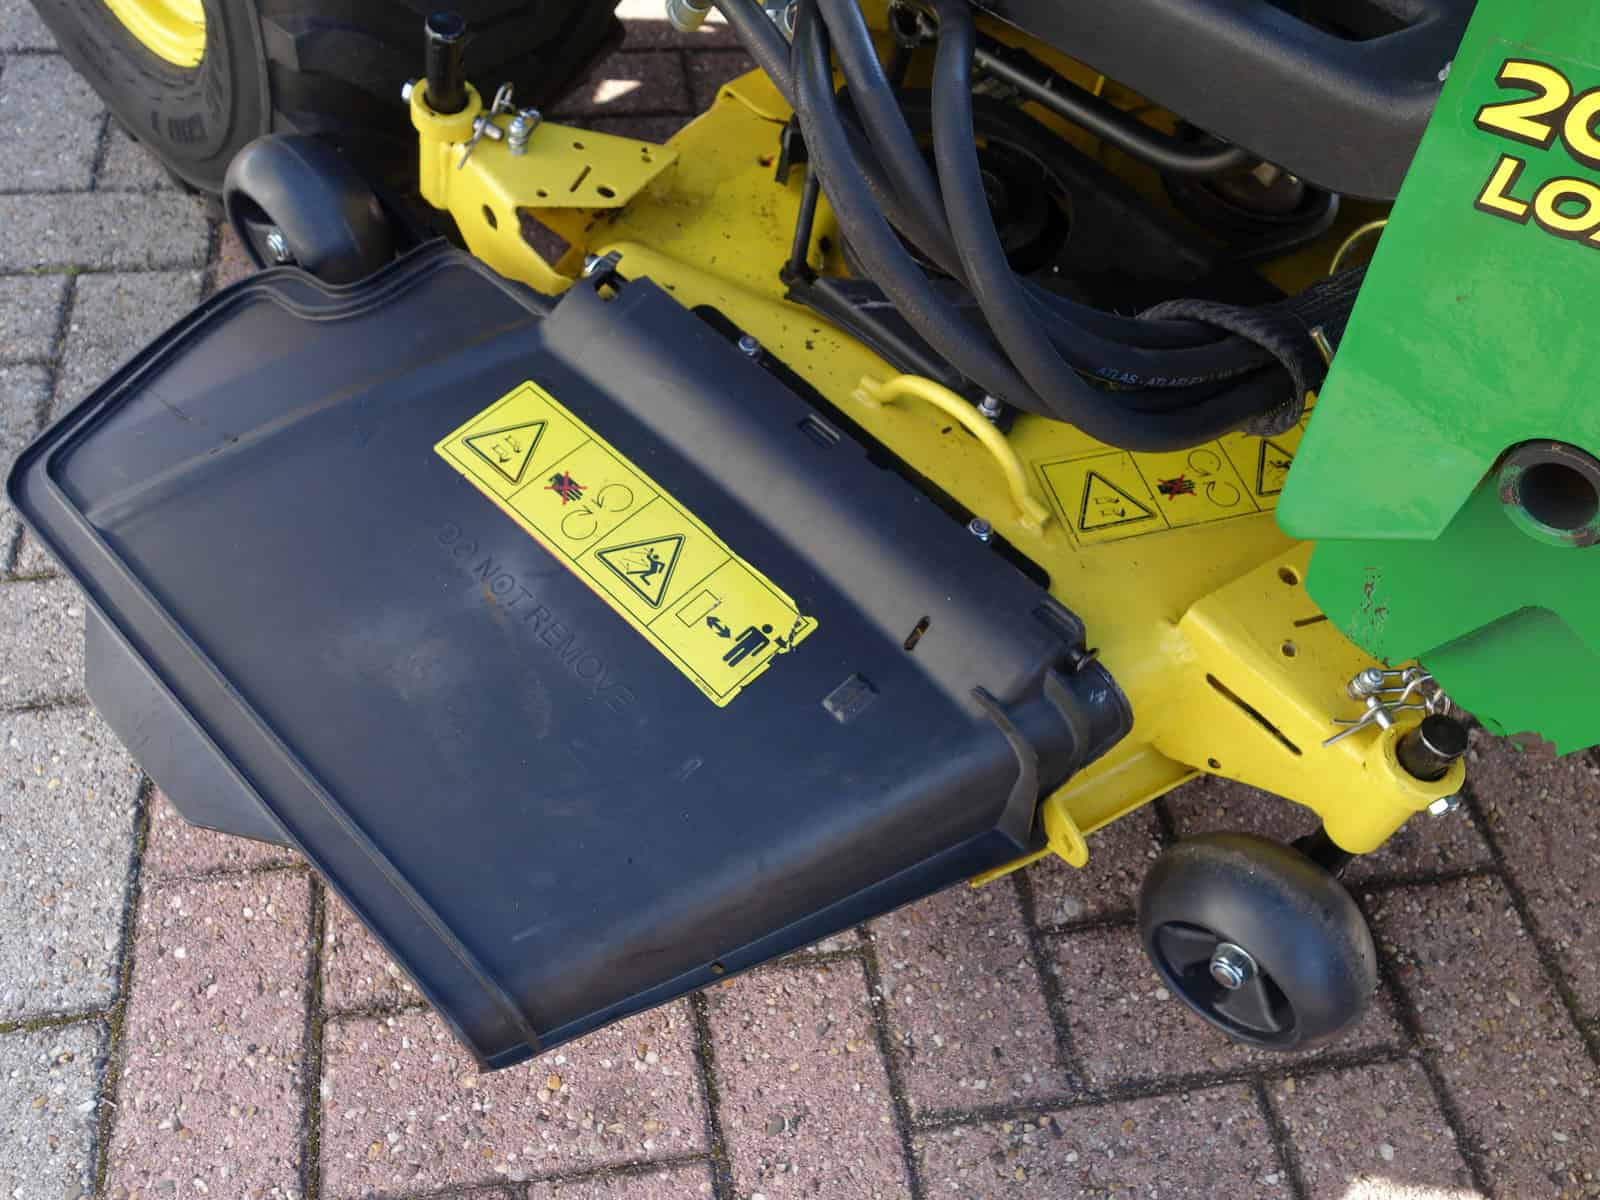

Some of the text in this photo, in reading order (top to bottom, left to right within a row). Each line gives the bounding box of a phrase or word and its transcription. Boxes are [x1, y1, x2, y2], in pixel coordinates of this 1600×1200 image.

[1474, 152, 1600, 249] LO
[434, 519, 479, 559] DO
[472, 550, 535, 608] NOT
[522, 603, 635, 713] REMOVE
